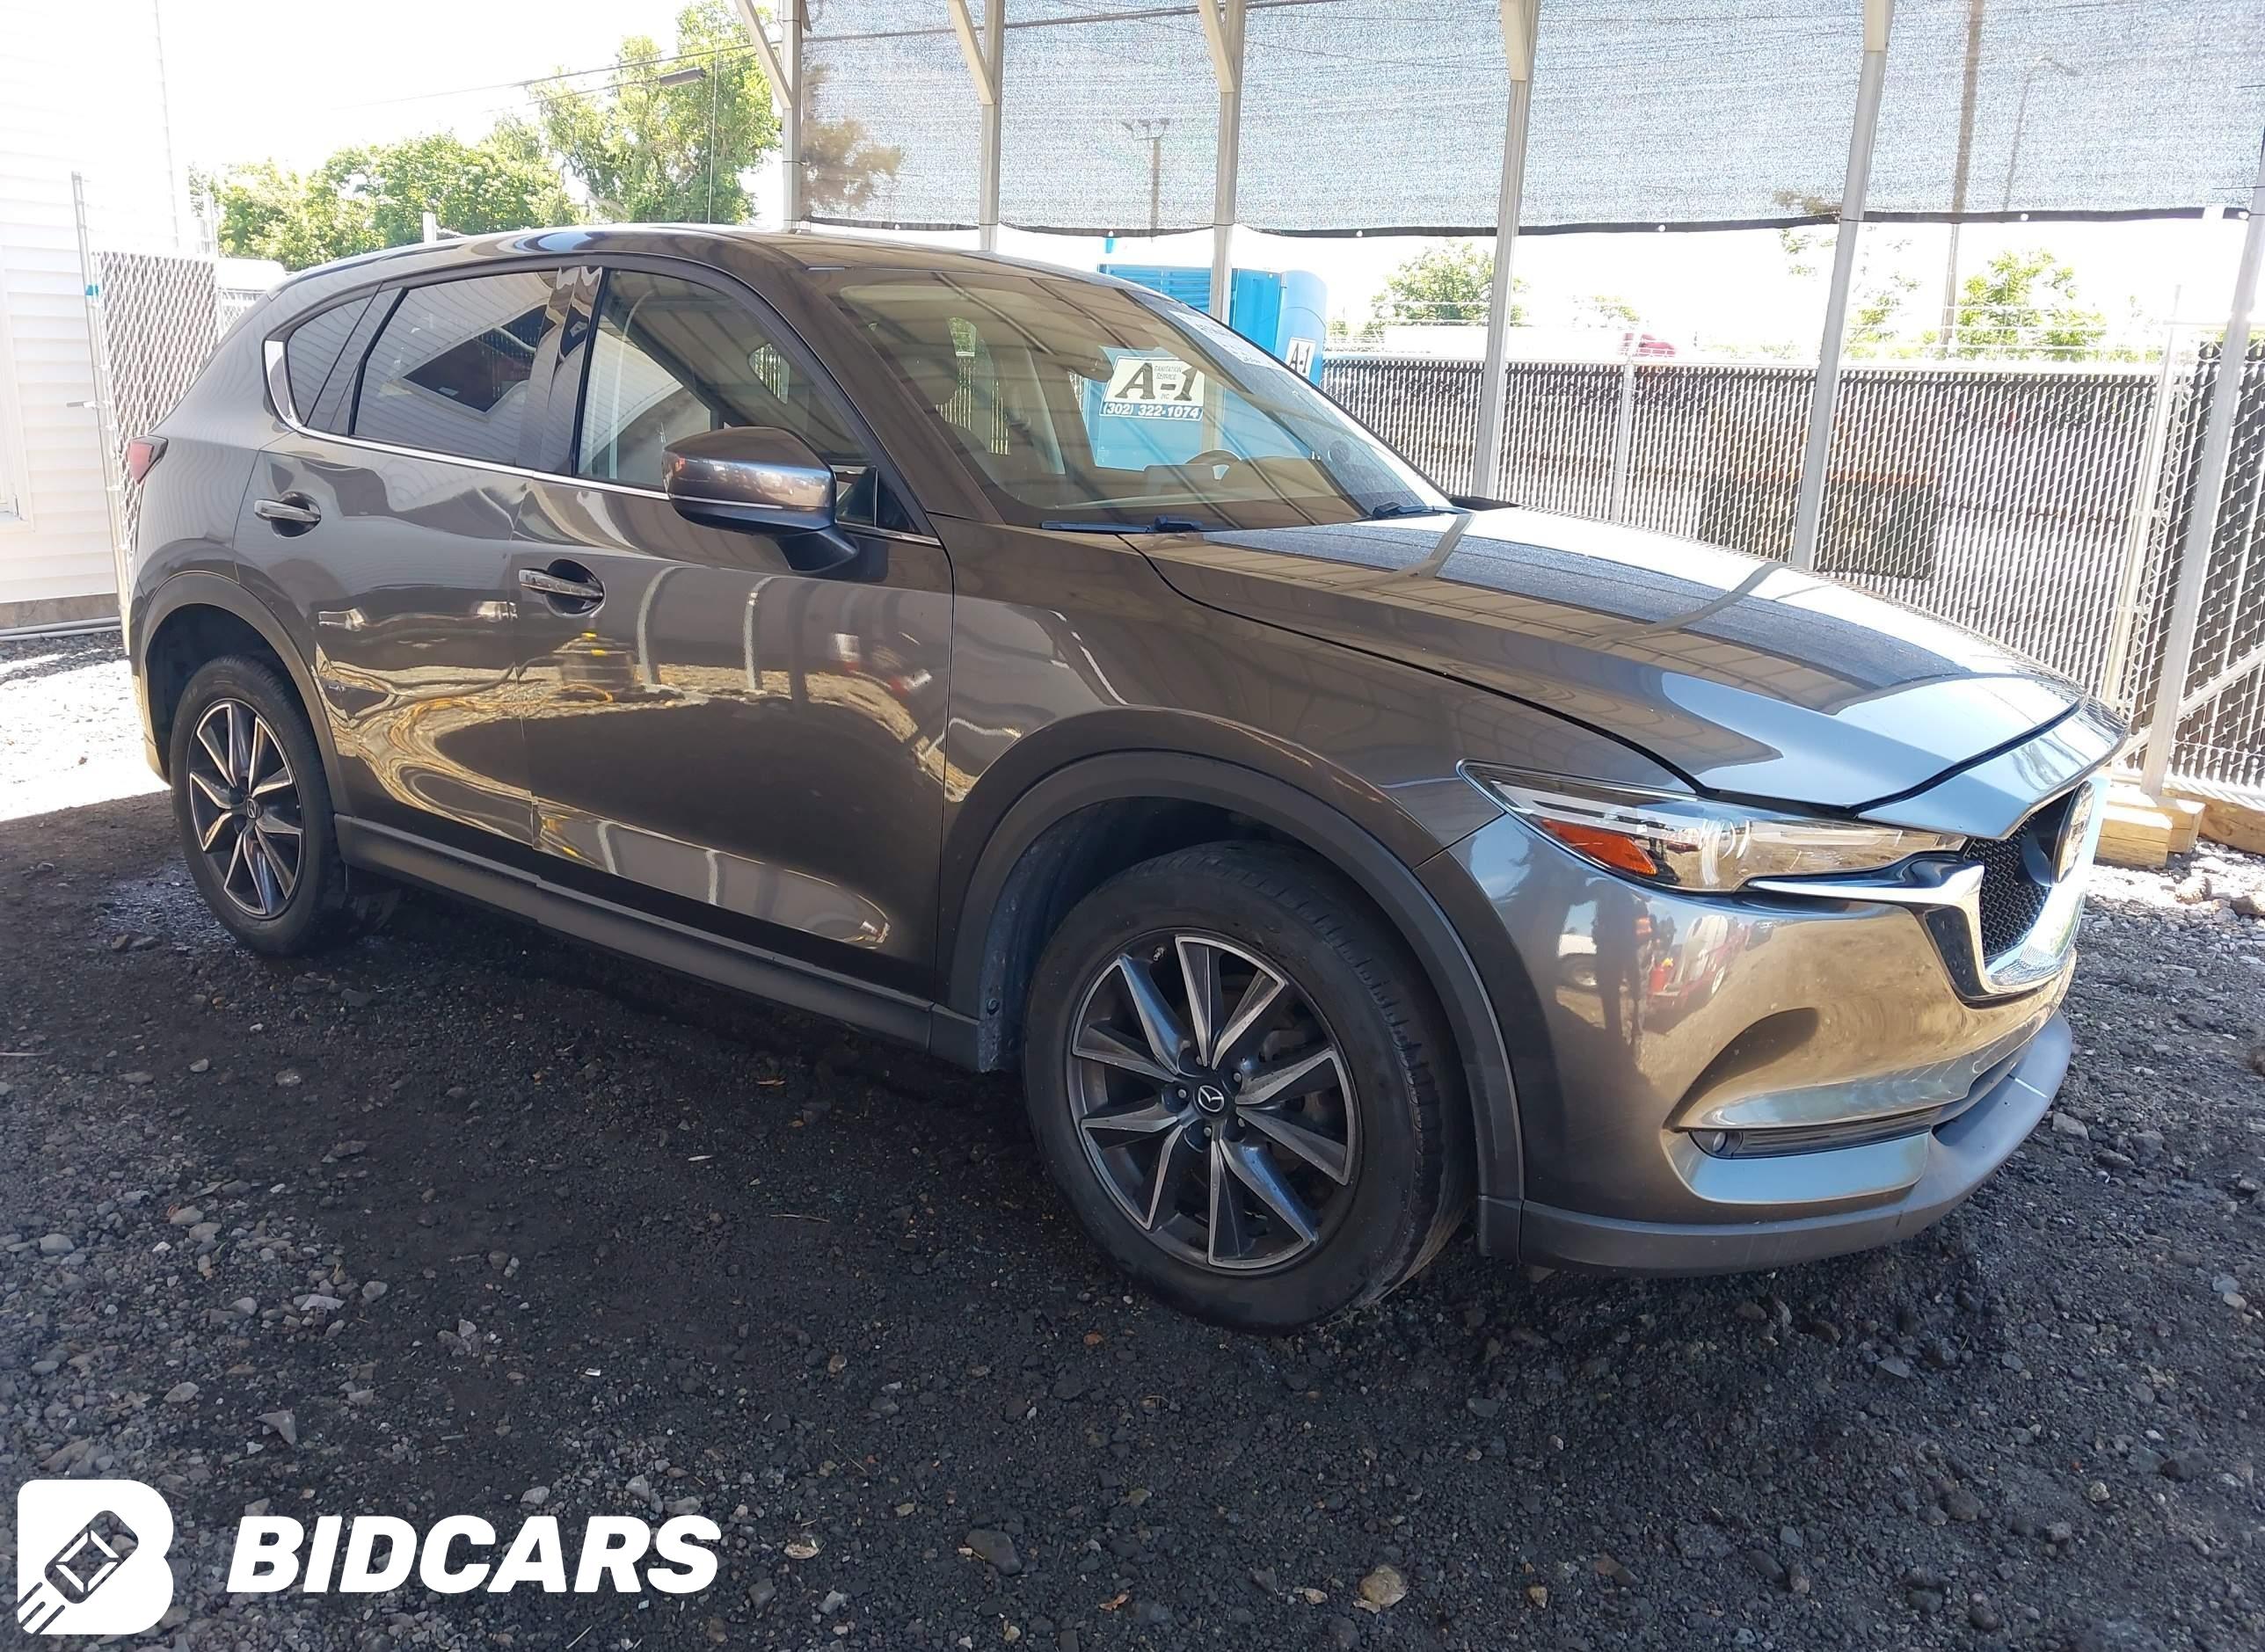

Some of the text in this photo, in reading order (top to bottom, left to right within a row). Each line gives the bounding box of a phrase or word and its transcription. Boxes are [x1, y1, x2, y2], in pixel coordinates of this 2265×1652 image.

[1289, 342, 1311, 374] A-1
[1114, 362, 1198, 401] A-1
[1103, 403, 1199, 418] (302) 322-1074
